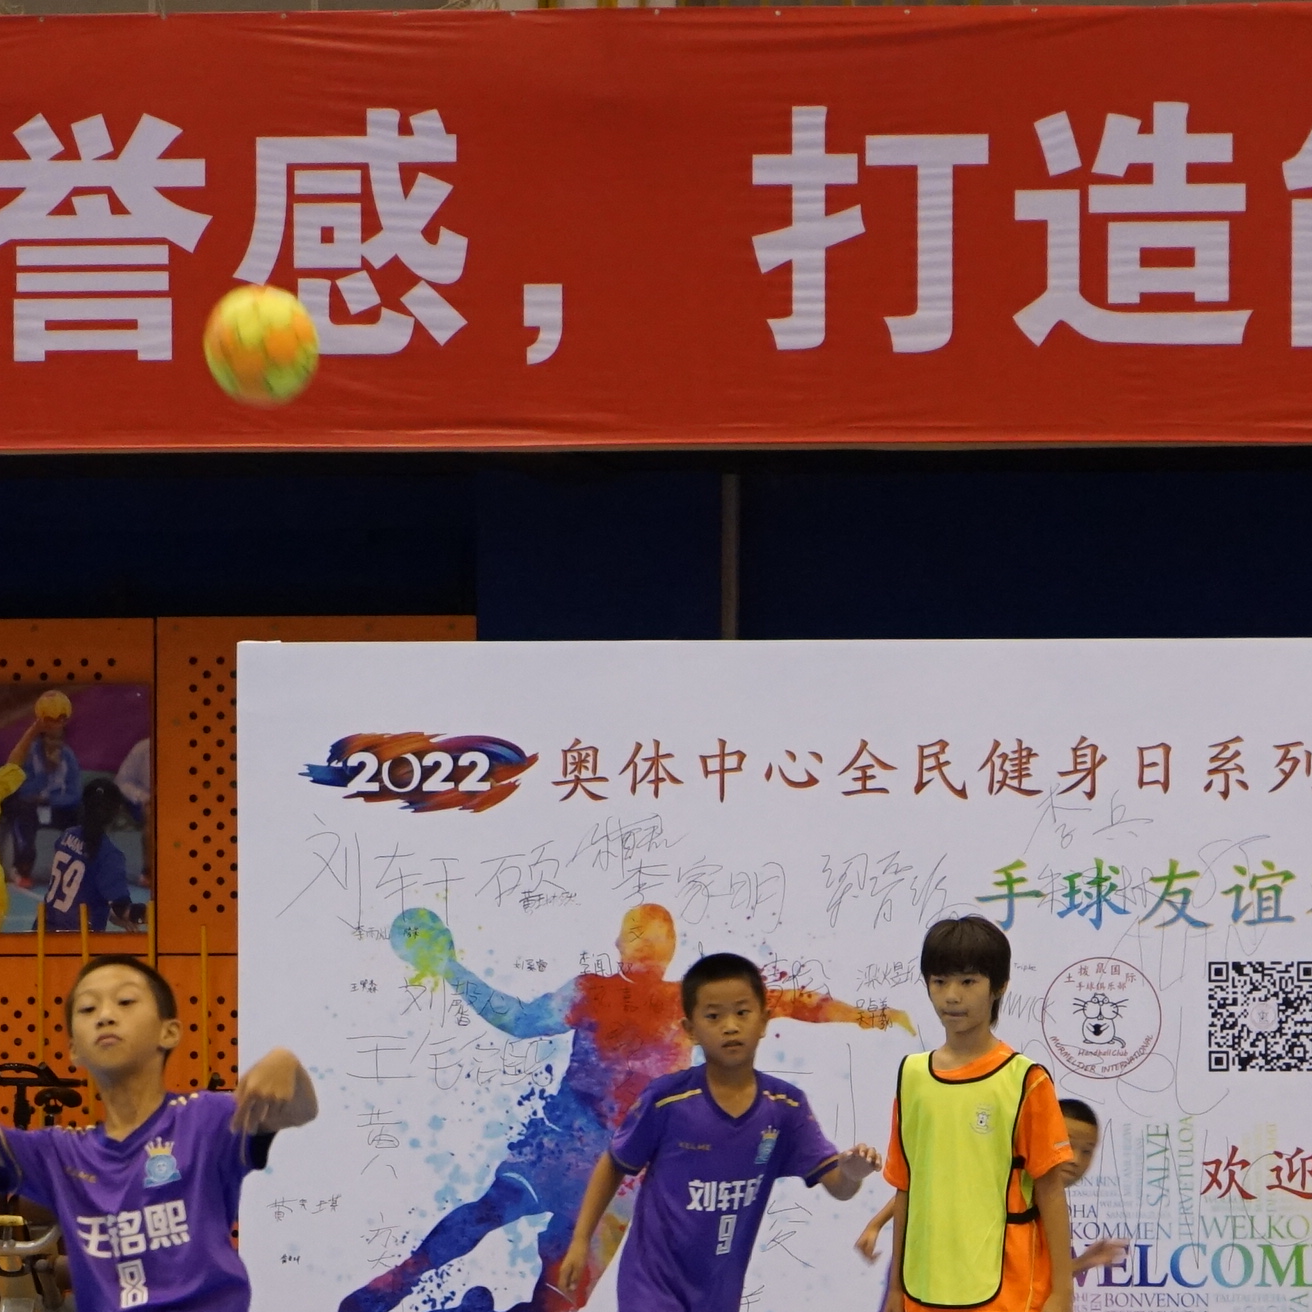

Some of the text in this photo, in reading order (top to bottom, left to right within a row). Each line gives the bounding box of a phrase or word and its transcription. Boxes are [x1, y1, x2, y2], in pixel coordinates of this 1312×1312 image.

[346, 750, 492, 793] 2022
[1146, 1122, 1170, 1208] SALVE
[1178, 1115, 1194, 1241] TERVETULOA
[714, 1214, 738, 1256] 9
[1104, 1292, 1210, 1308] BONVENON
